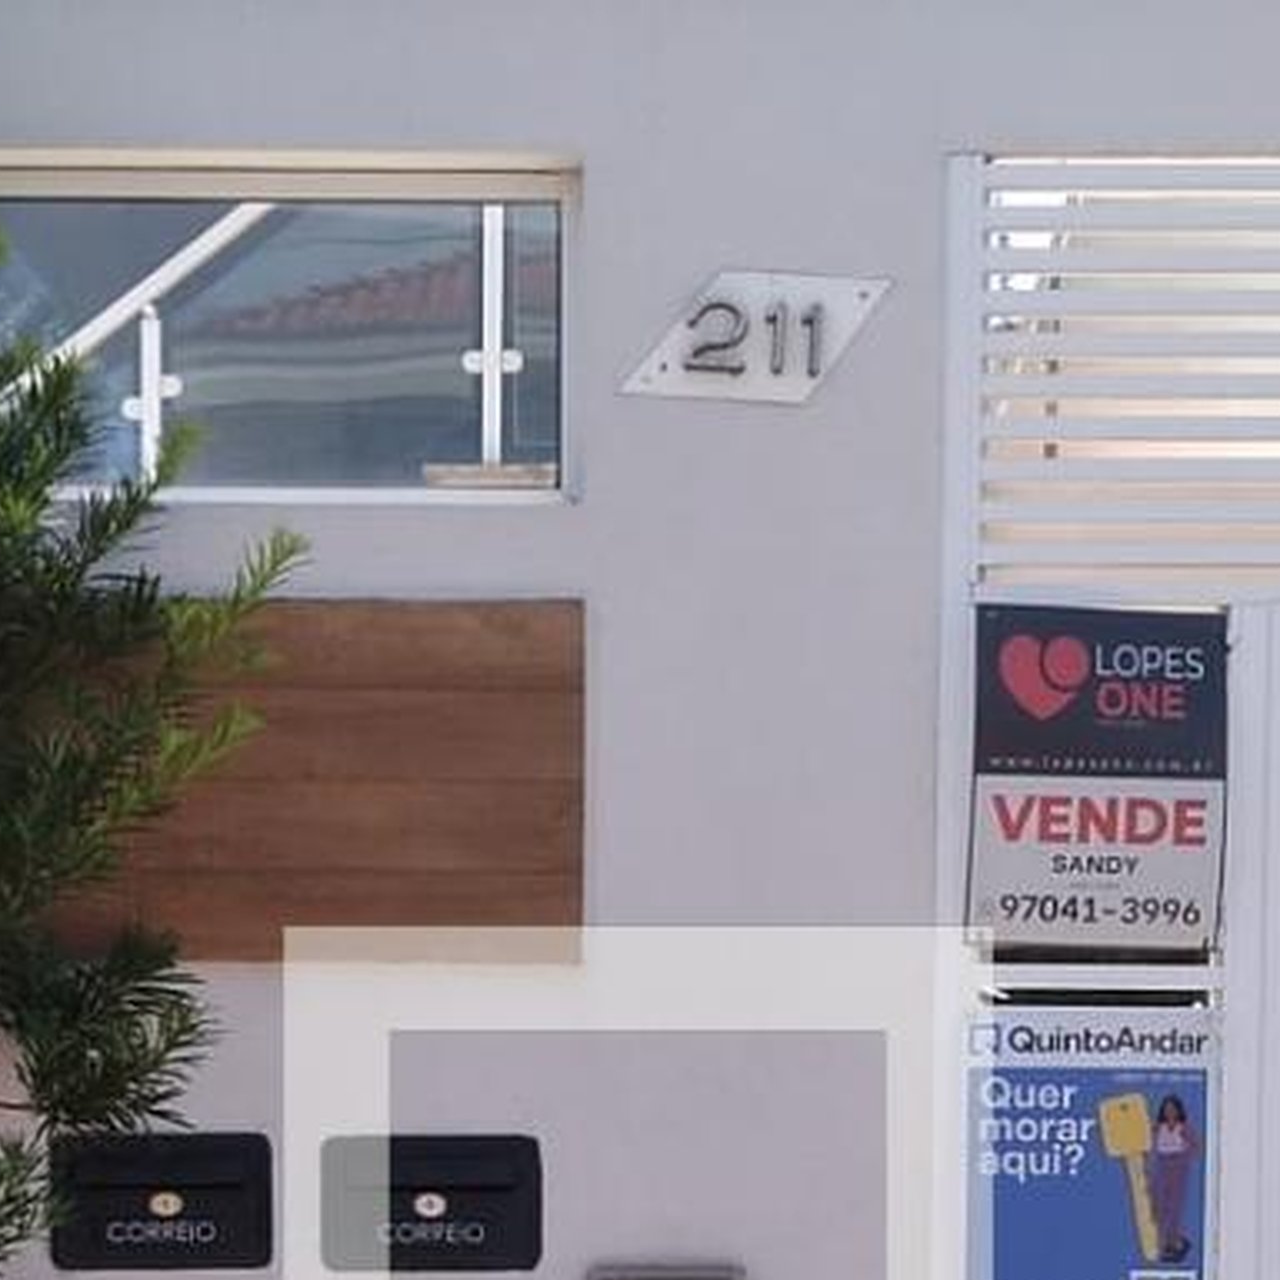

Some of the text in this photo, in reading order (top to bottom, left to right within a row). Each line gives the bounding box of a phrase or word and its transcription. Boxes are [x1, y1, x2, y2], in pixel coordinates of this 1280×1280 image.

[682, 301, 823, 378] 211
[1094, 644, 1205, 679] LOPES
[1096, 682, 1187, 720] ONE
[991, 794, 1208, 846] VENDE
[1051, 853, 1141, 876] SANDY
[999, 893, 1201, 926] 97041-3996
[1007, 1025, 1209, 1054] QuintoAndar
[981, 1075, 1079, 1109] Quer
[979, 1117, 1096, 1142] morar
[979, 1142, 1085, 1184] aqui?
[106, 1221, 217, 1243] CORREIO
[376, 1221, 485, 1244] CORREIO
